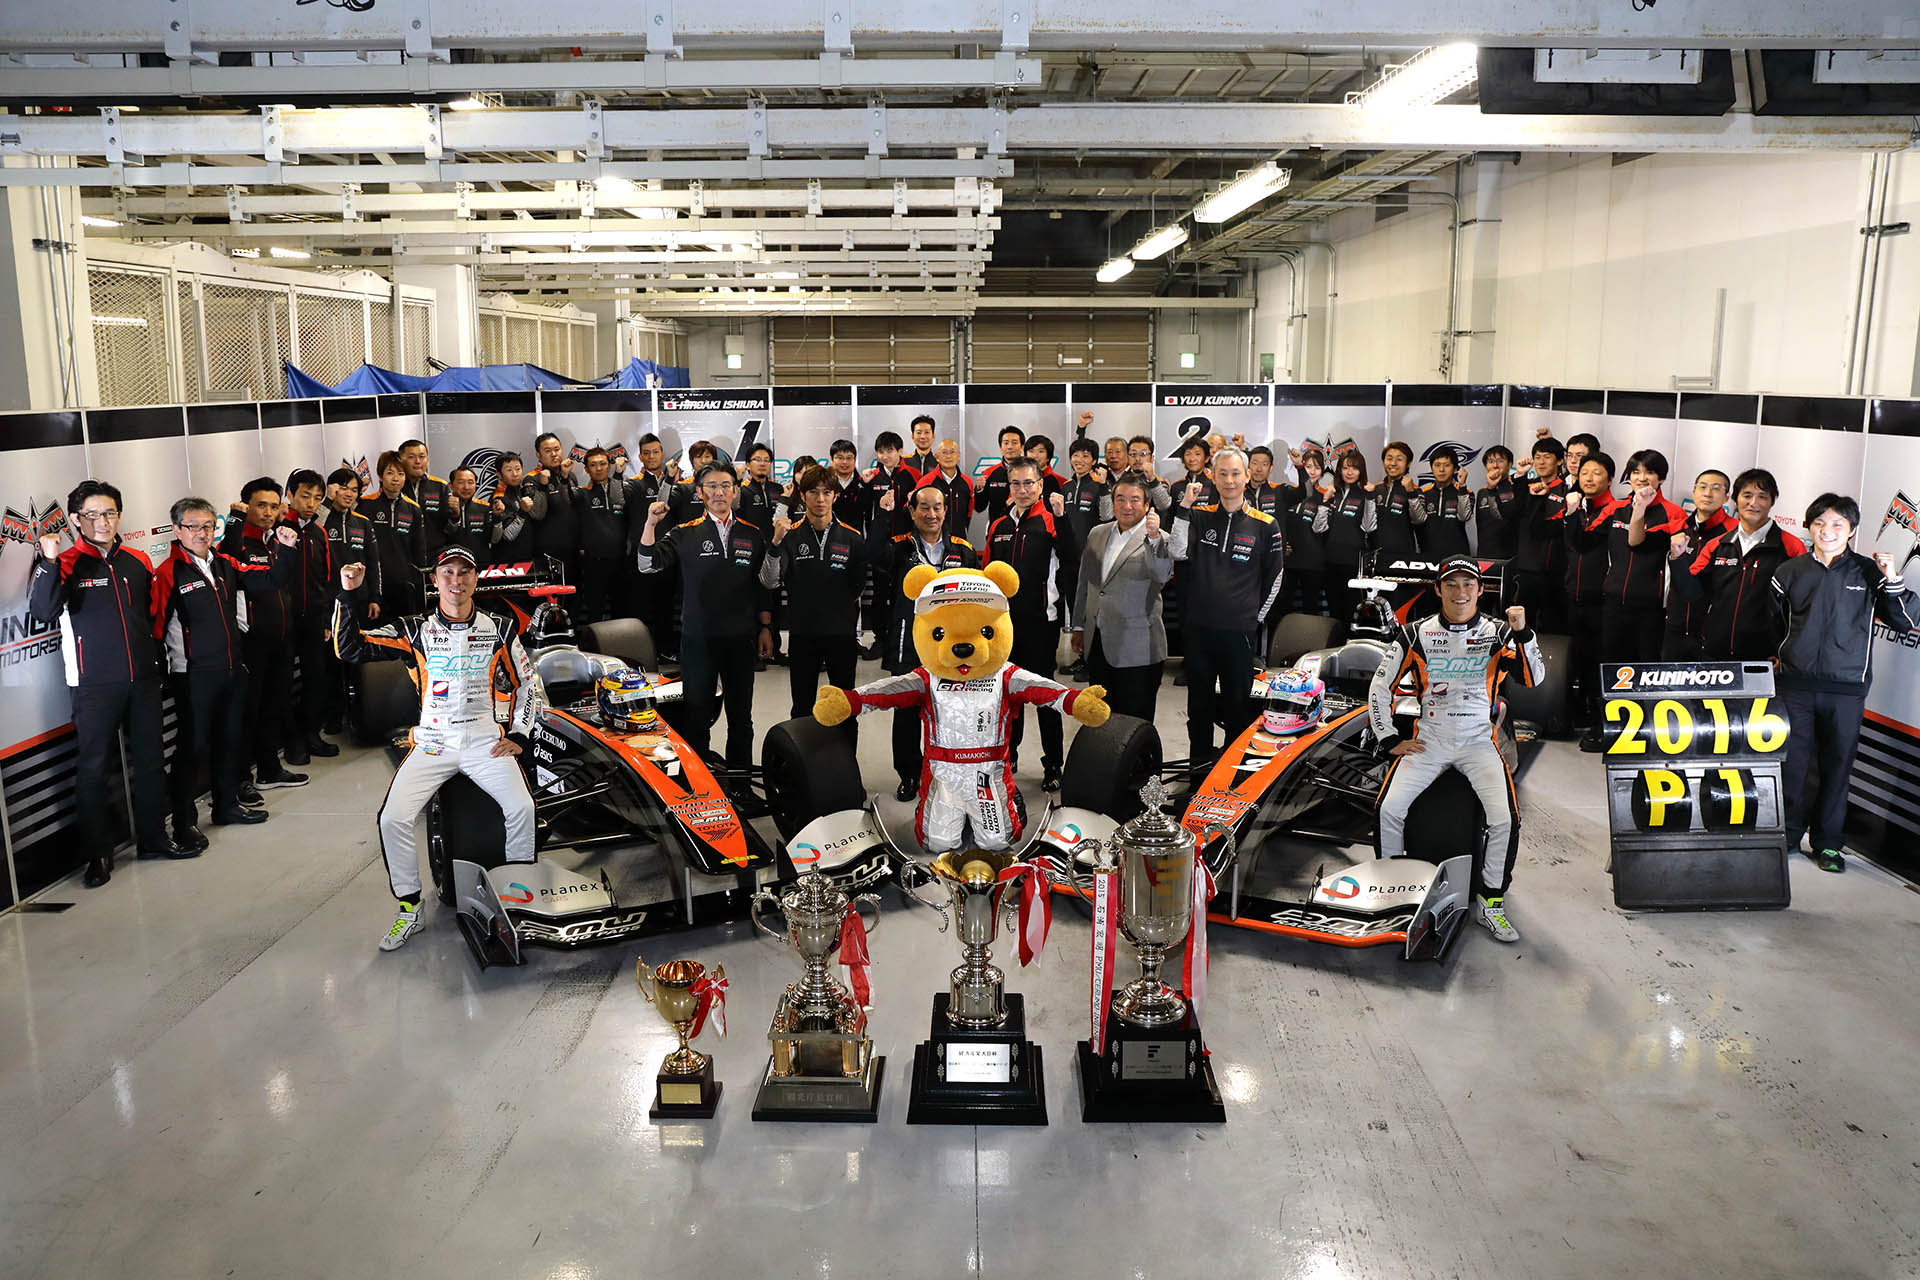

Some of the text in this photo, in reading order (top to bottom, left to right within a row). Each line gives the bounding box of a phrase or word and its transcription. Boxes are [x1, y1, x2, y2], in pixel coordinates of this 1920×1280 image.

[679, 400, 764, 409] HIROAKI ISHIURA
[1180, 396, 1262, 405] YUJI KUNIMOTO
[735, 419, 764, 462] 1
[1163, 415, 1213, 460] 2
[1775, 515, 1796, 526] TOYOTA
[123, 530, 146, 541] TOYOTA
[1389, 560, 1439, 572] ADV
[1448, 560, 1479, 572] YOKOHAMA
[1611, 666, 1735, 690] 2 KUNIMOTO
[937, 681, 966, 692] GR
[521, 688, 534, 727] INGING
[1371, 692, 1385, 731] CERUMO
[1605, 698, 1788, 754] 2016
[541, 730, 567, 751] CERUMO
[539, 748, 553, 763] asics
[664, 761, 680, 776] 1
[1231, 758, 1272, 772] 2
[979, 801, 988, 830] Racing
[984, 802, 994, 831] GAZOO
[990, 802, 1000, 834] TOYOTA
[696, 821, 737, 832] TOYOTA
[1097, 879, 1106, 898] 2015
[542, 896, 569, 904] CARS
[597, 925, 641, 937] PADS
